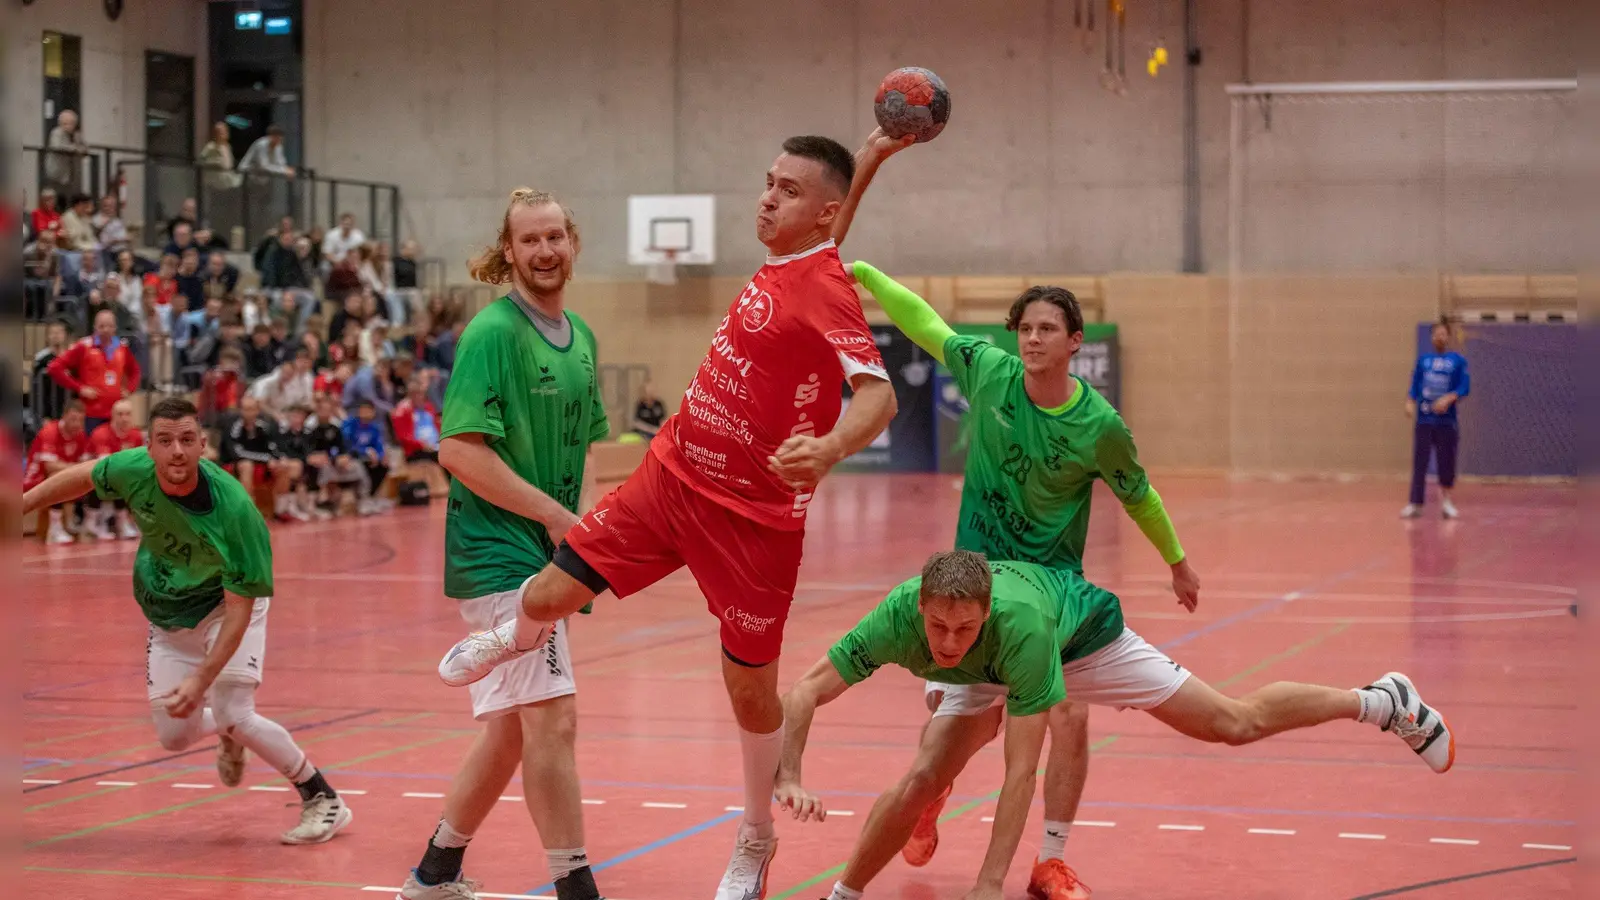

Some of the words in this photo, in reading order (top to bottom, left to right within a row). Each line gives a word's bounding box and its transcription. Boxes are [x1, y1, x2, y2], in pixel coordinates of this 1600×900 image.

[685, 440, 727, 463] engelhardt
[1000, 443, 1033, 486] 28
[164, 532, 192, 567] 24
[736, 608, 777, 626] Schöpper
[742, 620, 767, 632] Knoll
